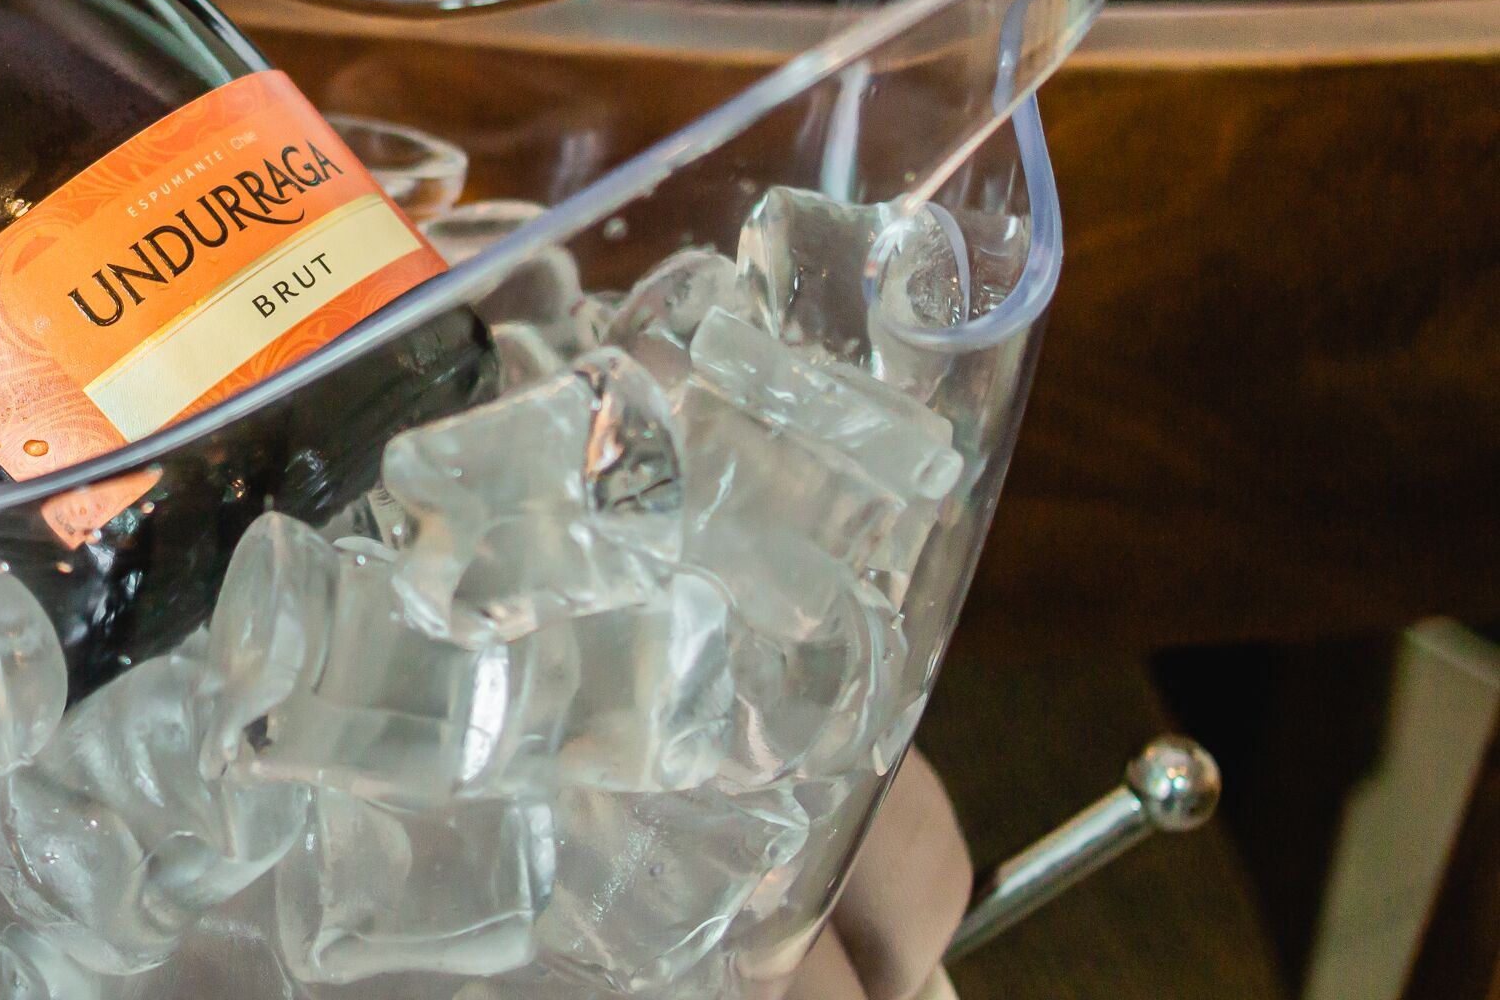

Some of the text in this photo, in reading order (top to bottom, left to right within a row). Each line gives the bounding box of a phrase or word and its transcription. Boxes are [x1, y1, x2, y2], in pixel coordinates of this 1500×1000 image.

[127, 150, 224, 218] ESPUMANTE
[67, 139, 344, 327] UNDURRAGA
[251, 252, 332, 318] BRUT
